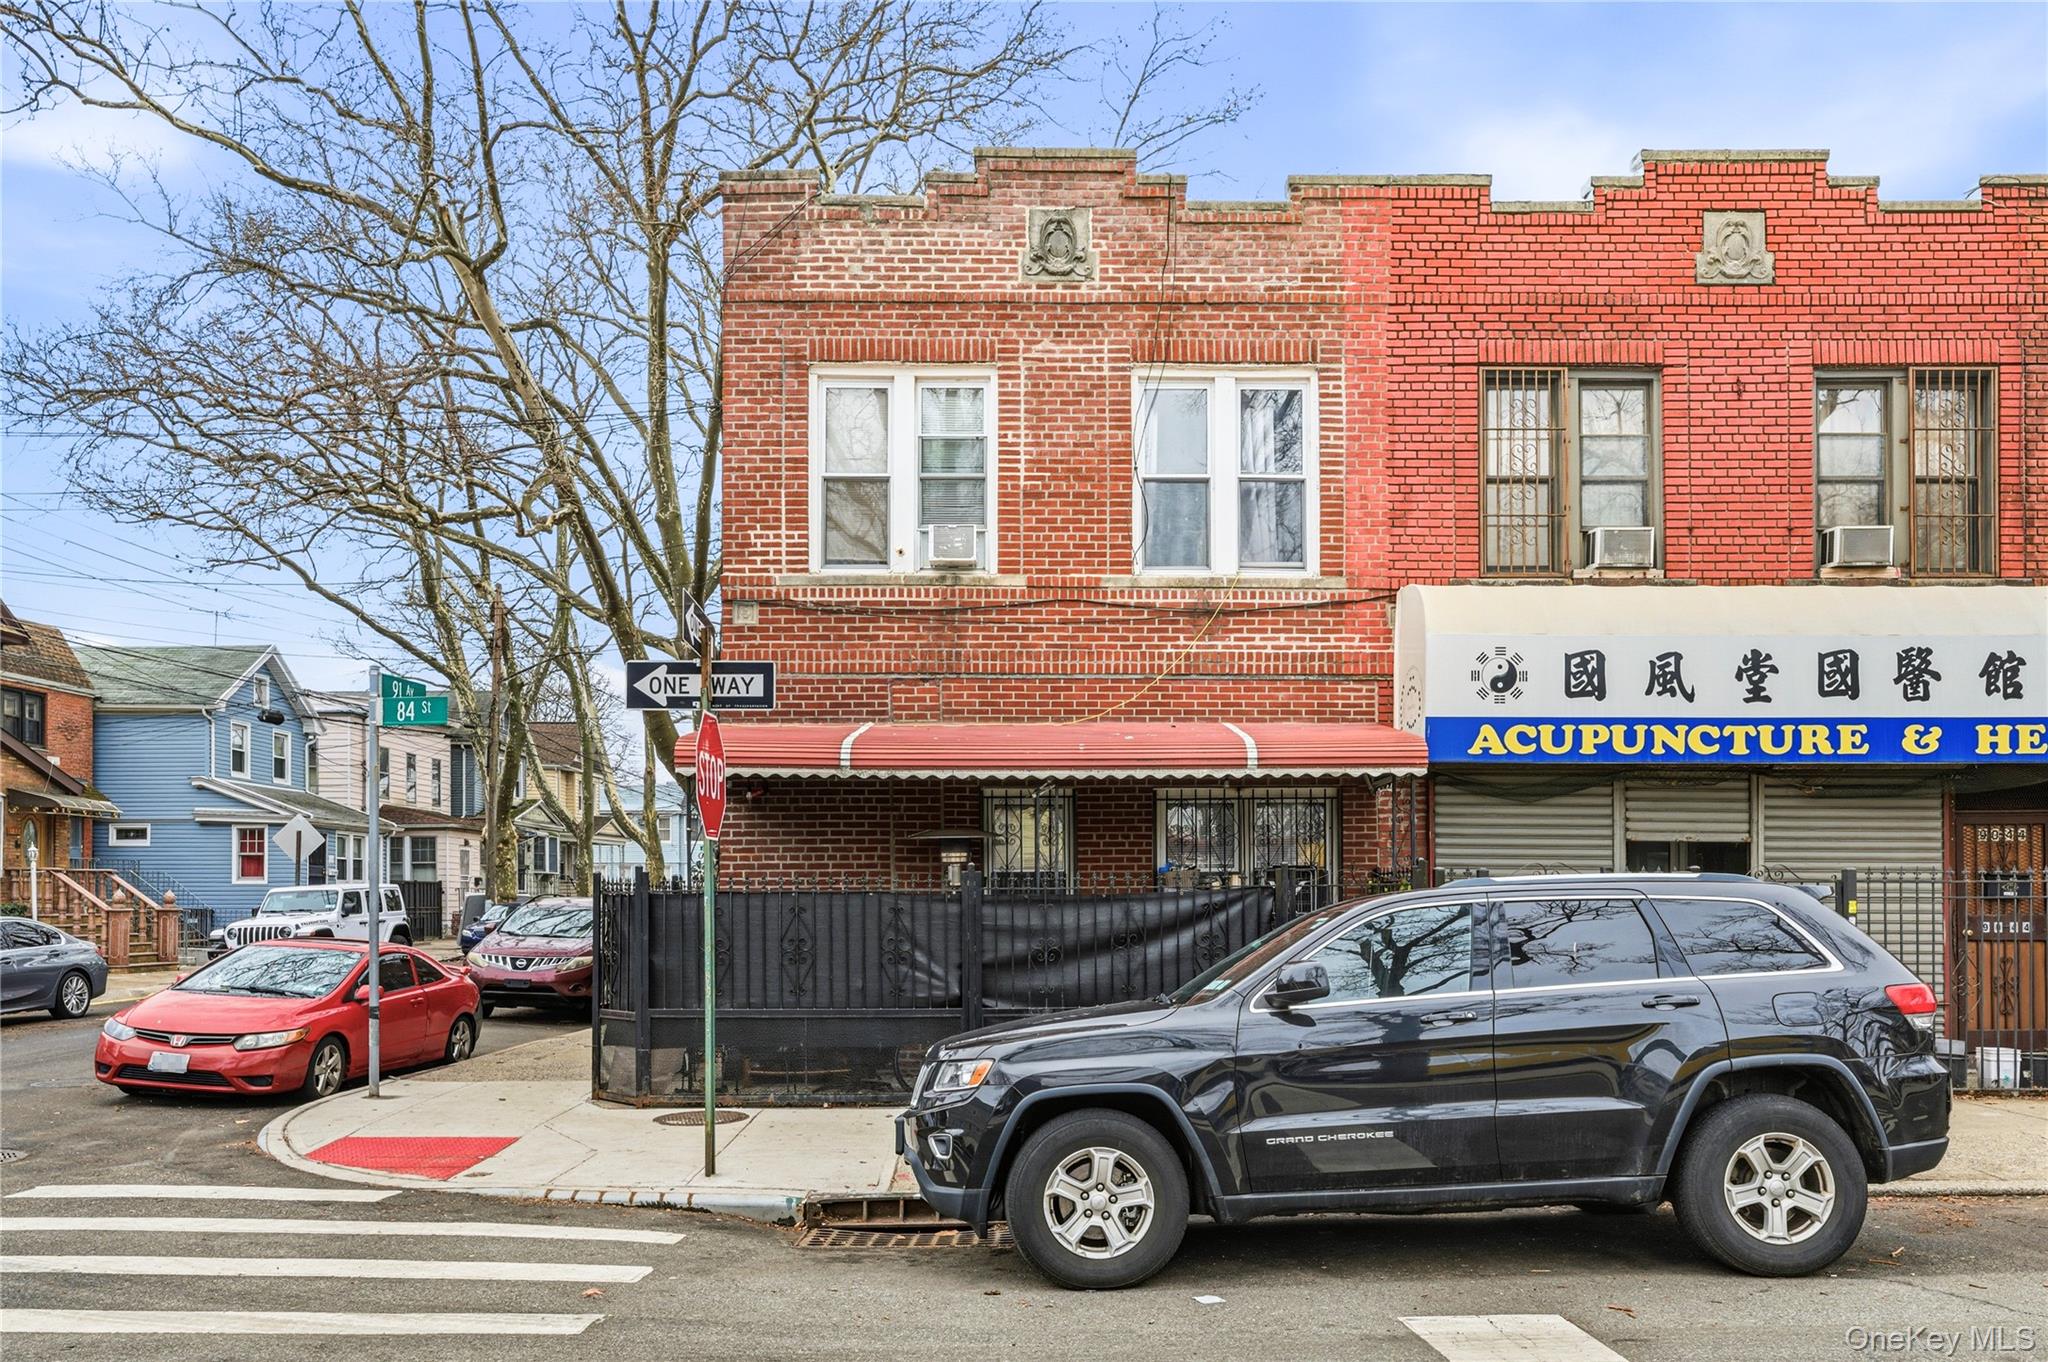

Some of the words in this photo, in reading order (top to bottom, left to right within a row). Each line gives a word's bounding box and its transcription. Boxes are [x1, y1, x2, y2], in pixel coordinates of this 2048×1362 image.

[649, 676, 690, 694] ONE
[711, 676, 755, 694] WAY
[1563, 647, 2027, 704] 國風堂國醫館
[392, 680, 402, 698] 91
[397, 701, 415, 721] 84
[421, 700, 432, 714] St
[1467, 723, 1870, 755] ACUPUNCTURE
[1901, 723, 1943, 755] &
[1974, 723, 2048, 755] HE
[698, 750, 725, 800] STOP
[1266, 1135, 1314, 1145] GRAND
[1317, 1130, 1394, 1142] CHEROKEE
